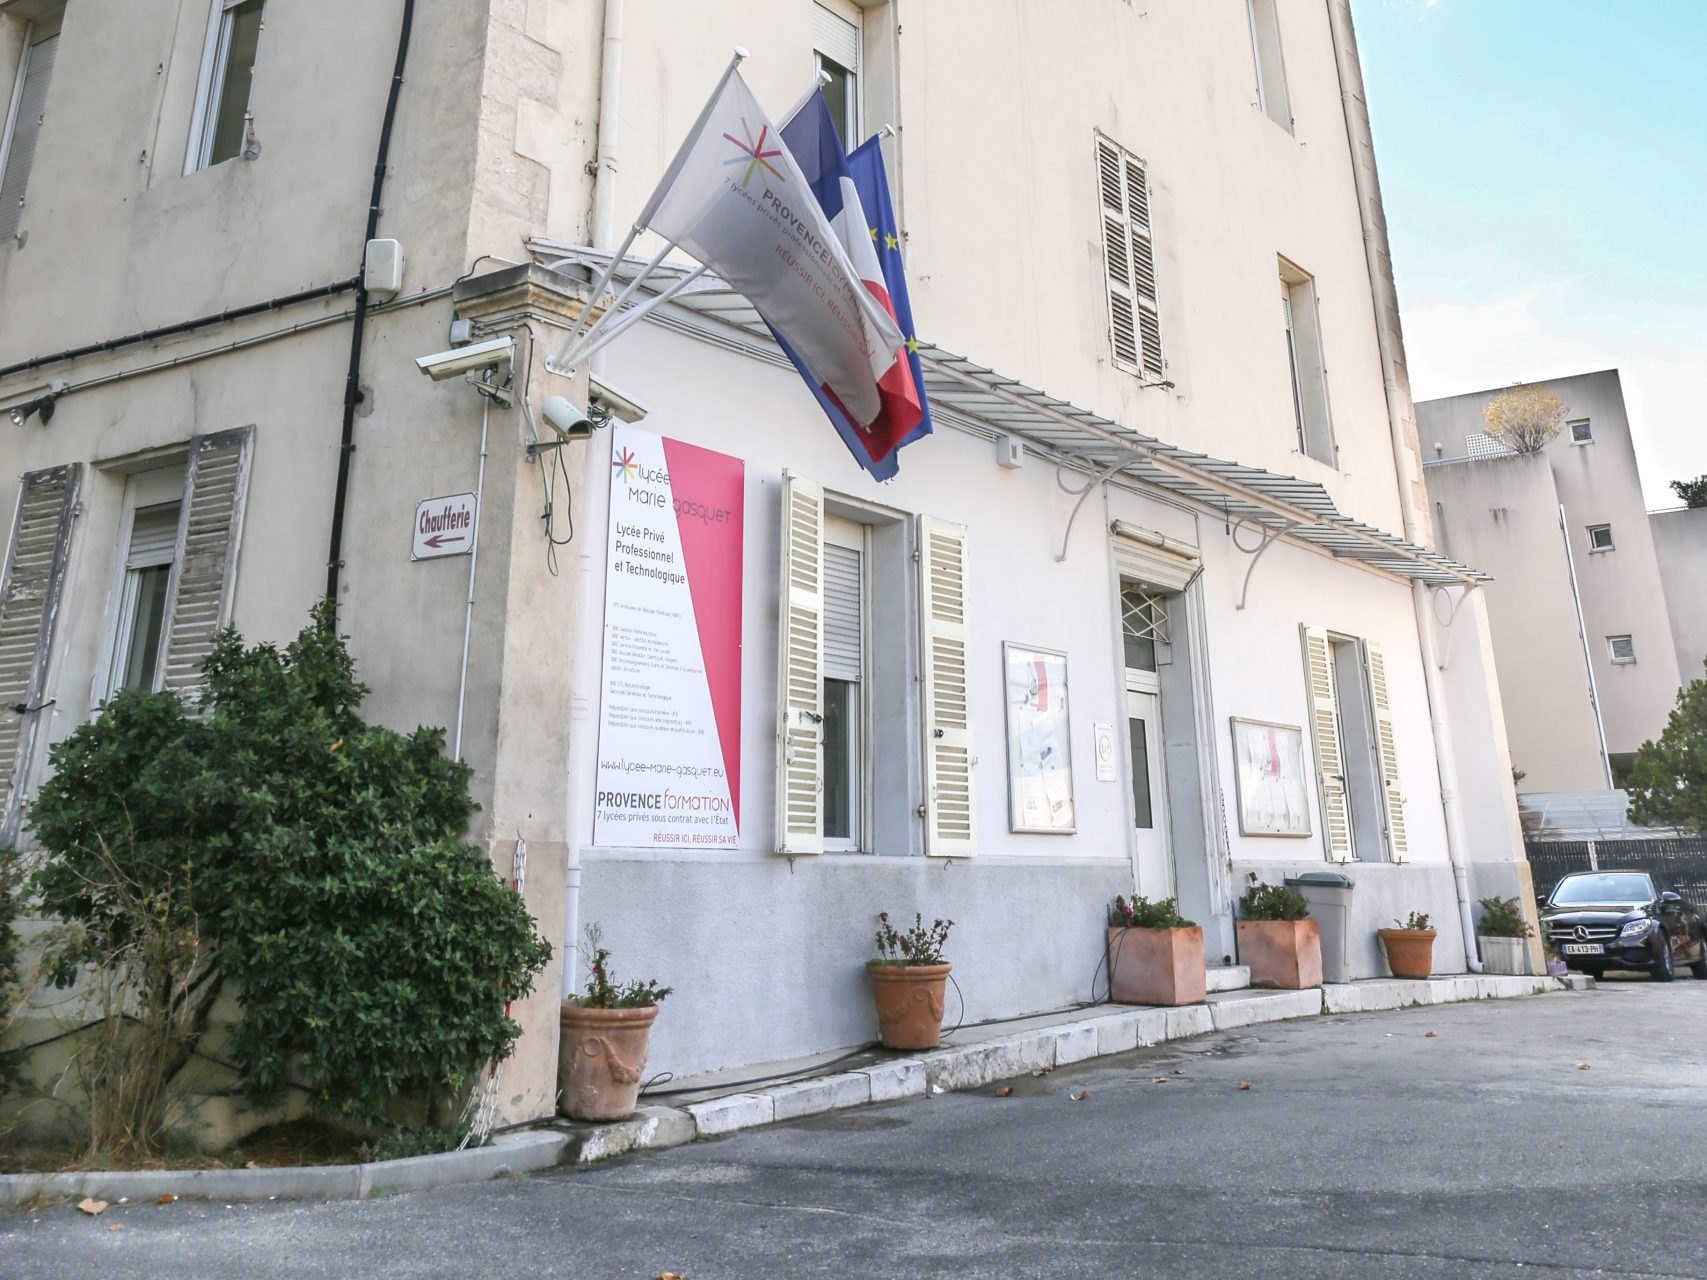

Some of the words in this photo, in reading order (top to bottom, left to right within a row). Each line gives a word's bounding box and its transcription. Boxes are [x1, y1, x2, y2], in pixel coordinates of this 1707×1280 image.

[763, 188, 829, 263] PROVENCE
[639, 464, 670, 485] lycée
[628, 487, 666, 508] Marie
[419, 503, 470, 535] Chaufferie
[616, 521, 641, 538] Lycée
[643, 527, 665, 543] Privé
[616, 540, 674, 564] Professionnel
[614, 561, 623, 572] et
[625, 561, 685, 585] Technologique
[598, 792, 661, 809] PROVENCE
[597, 810, 602, 820] 7
[603, 811, 627, 822] lycées
[628, 812, 650, 823] privés
[651, 815, 666, 823] sous
[668, 815, 692, 824] contrat
[694, 816, 709, 824] avec
[719, 835, 728, 844] SA
[728, 835, 737, 844] VIE
